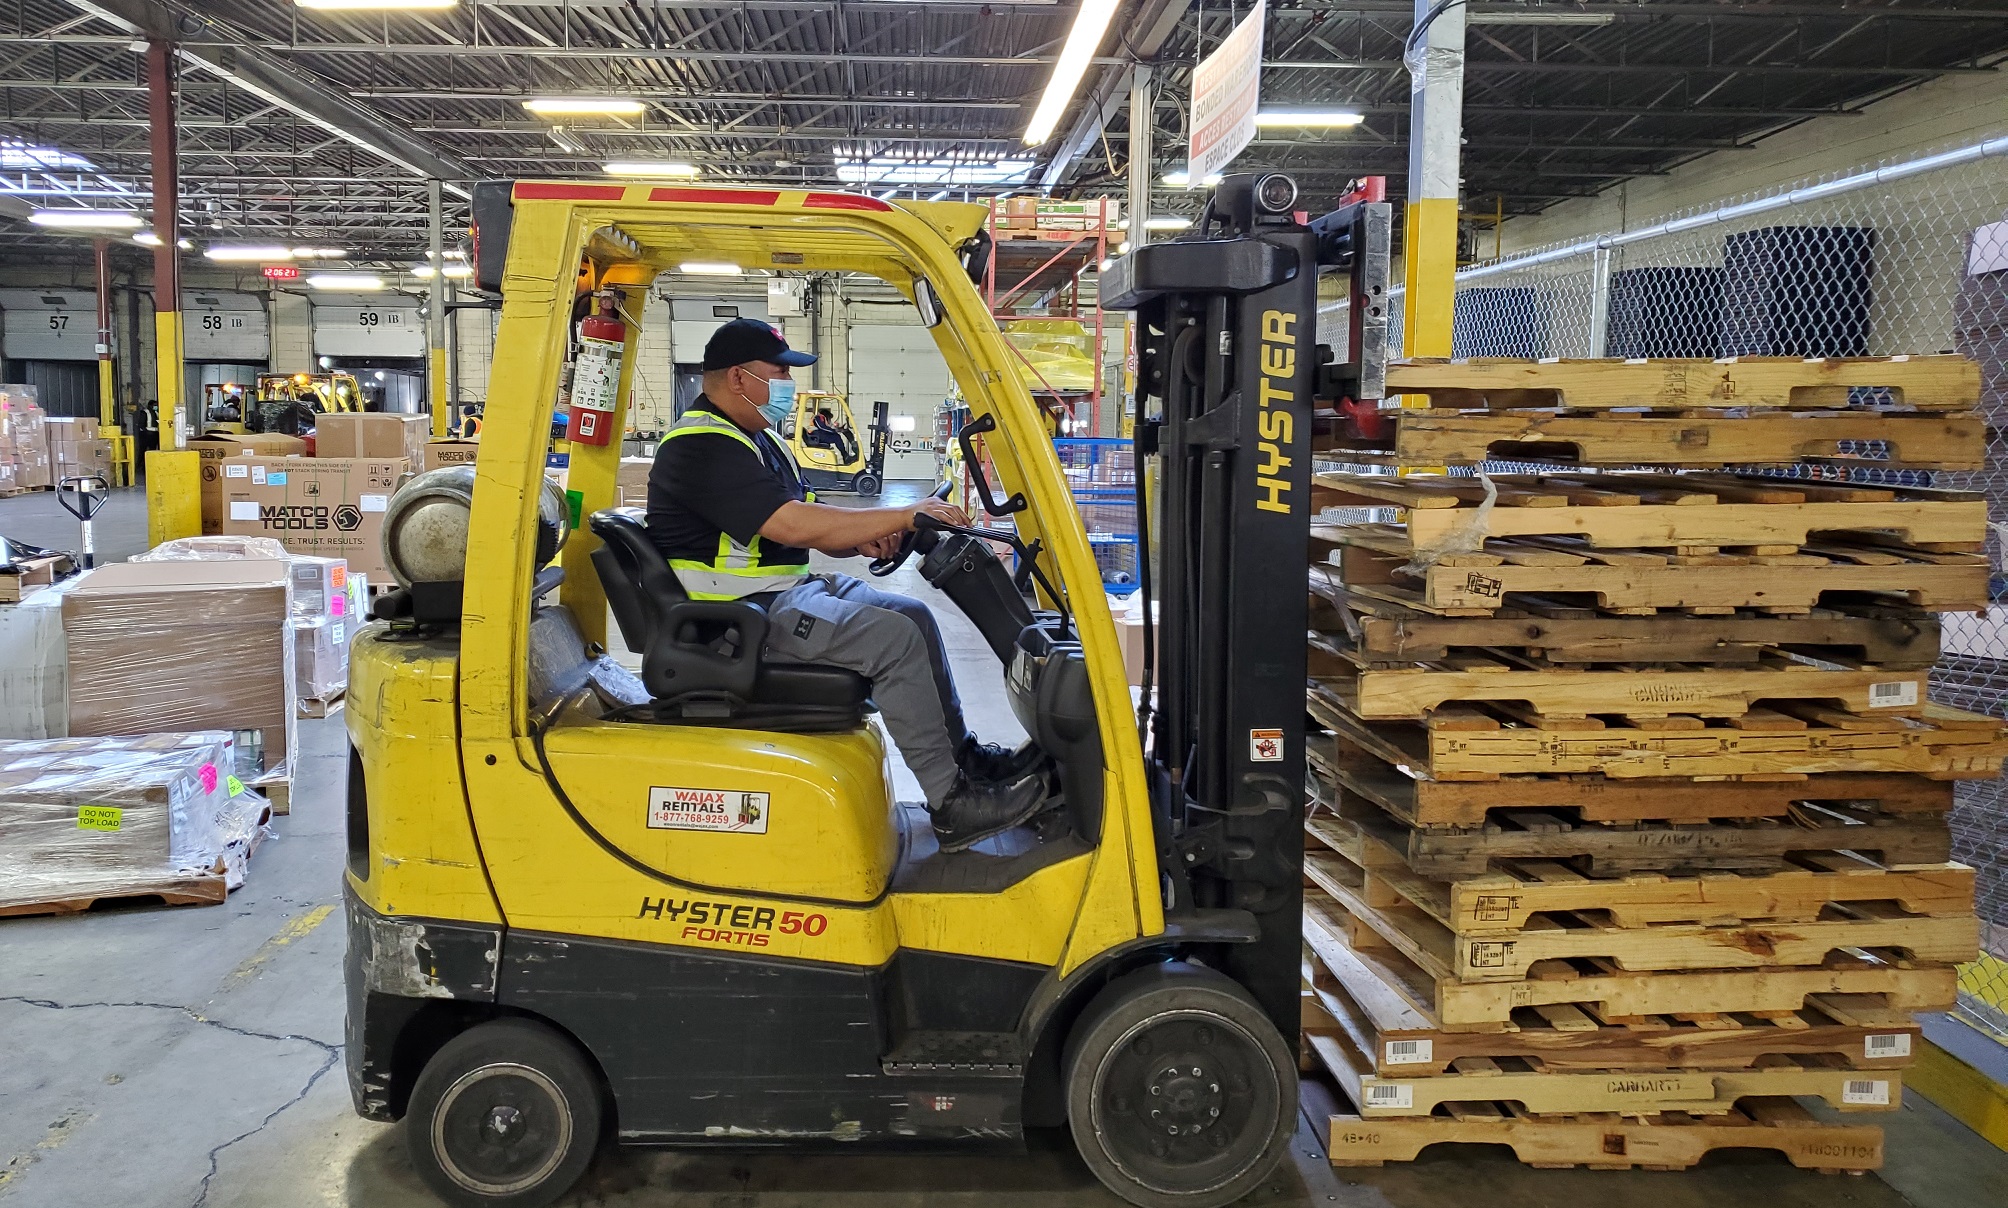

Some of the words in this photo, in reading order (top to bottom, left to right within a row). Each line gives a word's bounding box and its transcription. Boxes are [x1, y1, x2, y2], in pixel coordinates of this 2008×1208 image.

[1196, 84, 1223, 122] BONDED
[1199, 119, 1221, 150] ACCES
[1204, 137, 1229, 174] ESPACE
[50, 316, 69, 330] 57
[202, 316, 222, 330] 58
[231, 318, 243, 328] IB
[359, 312, 379, 326] 59
[388, 313, 399, 324] IB
[1256, 309, 1297, 514] HYSTER
[893, 440, 911, 453] 62
[260, 506, 329, 517] MATCO
[263, 517, 329, 530] TOOLS
[298, 537, 325, 545] TRUST.
[675, 791, 725, 805] WAJAX
[84, 809, 97, 817] DO
[98, 810, 116, 818] NOT
[662, 801, 725, 814] RENTALS
[79, 817, 95, 825] TOP
[96, 819, 119, 827] LOAD
[654, 811, 729, 825] 1-877-768-9259
[635, 897, 775, 930] HYSTER
[778, 911, 828, 937] 50
[681, 926, 770, 947] FORTIS
